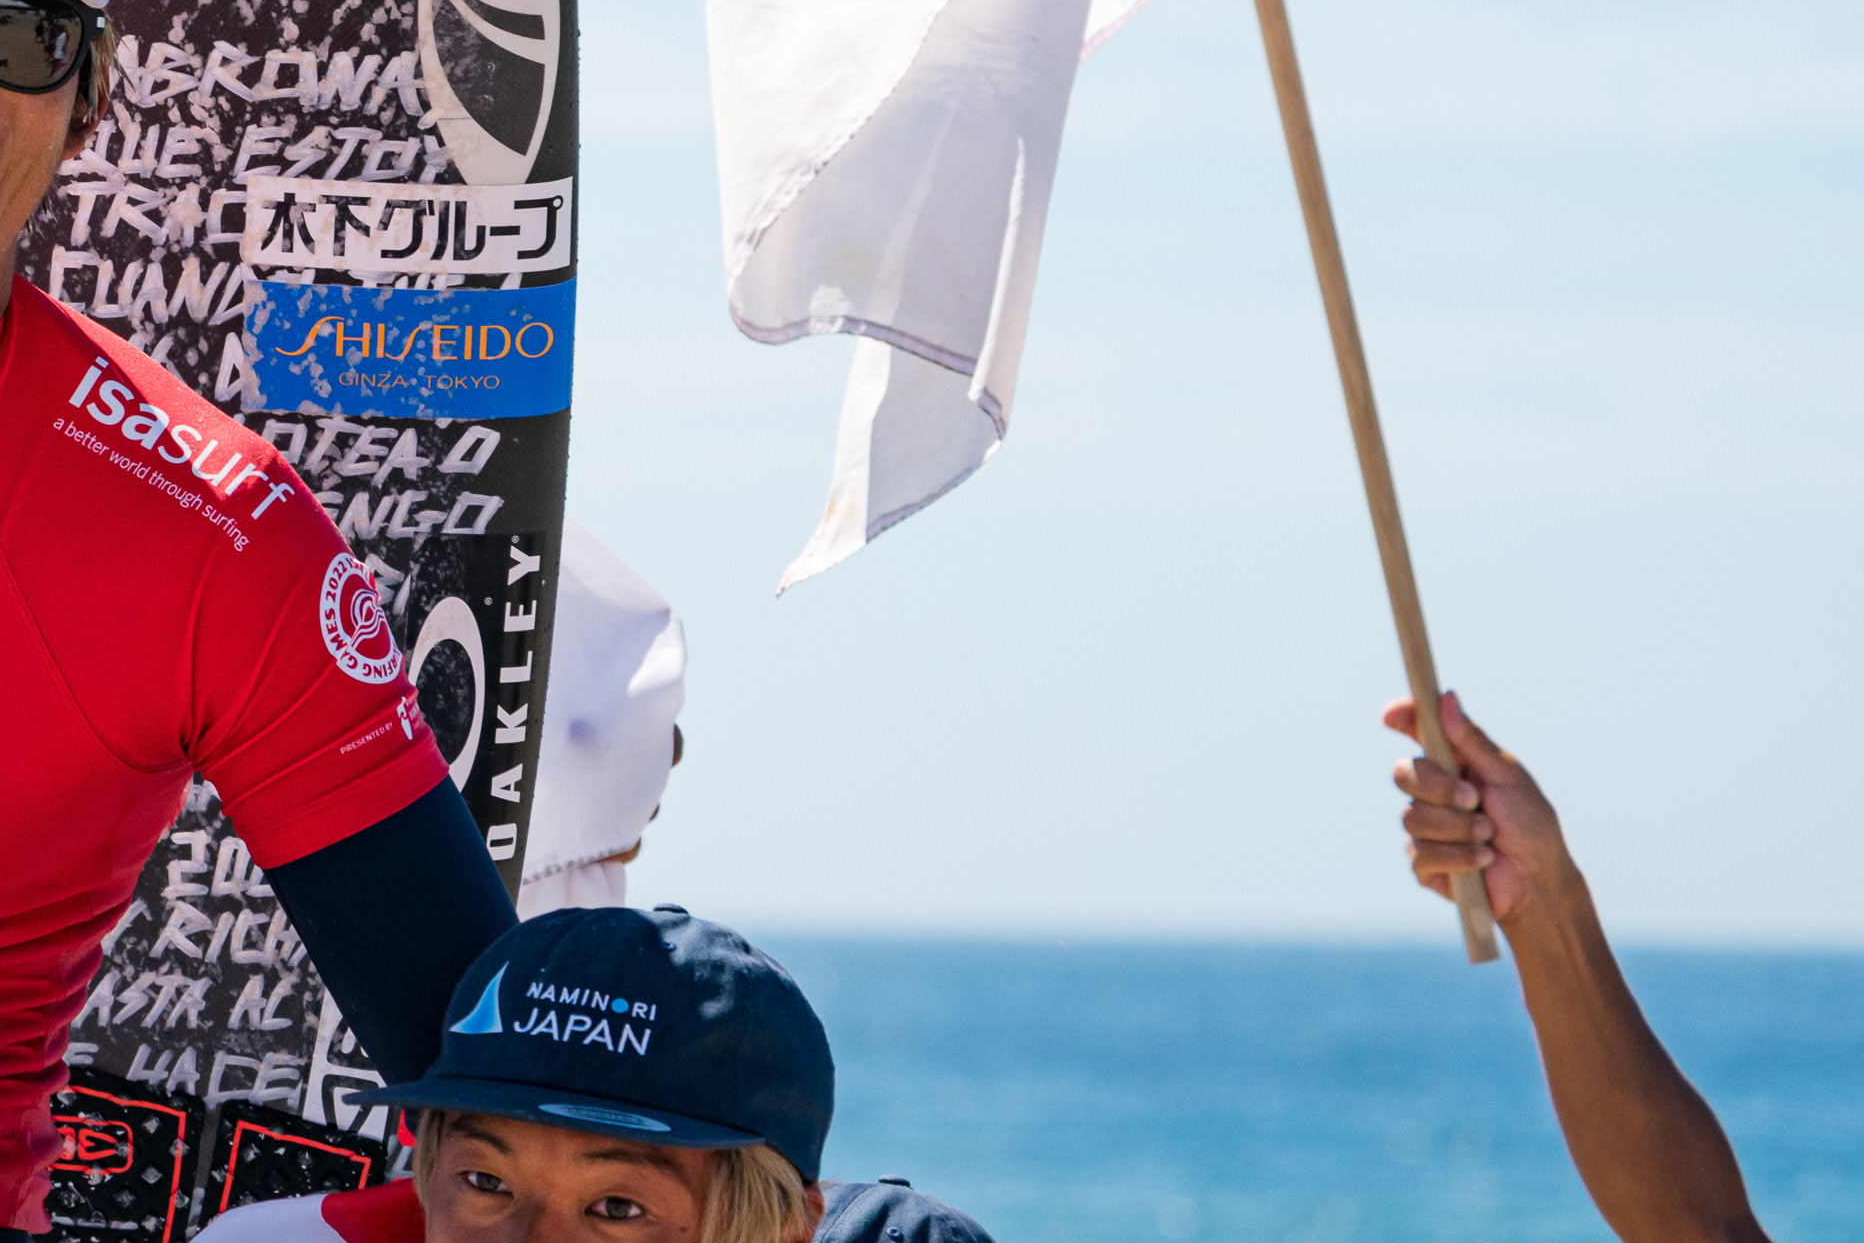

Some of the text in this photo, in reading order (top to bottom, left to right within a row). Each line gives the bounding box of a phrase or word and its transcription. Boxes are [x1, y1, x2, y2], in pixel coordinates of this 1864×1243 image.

[261, 191, 565, 260] 木下グループ
[275, 315, 554, 361] SHISEIDO
[338, 371, 500, 389] GINZA TOKYO
[68, 356, 296, 520] isasurf
[53, 418, 250, 553] a better world through surfing
[326, 561, 348, 603] 2022
[325, 607, 359, 670] GAMES
[487, 547, 540, 861] OAKLEY
[339, 721, 394, 755] PRESENTED BY
[513, 1007, 652, 1057] JAPAN
